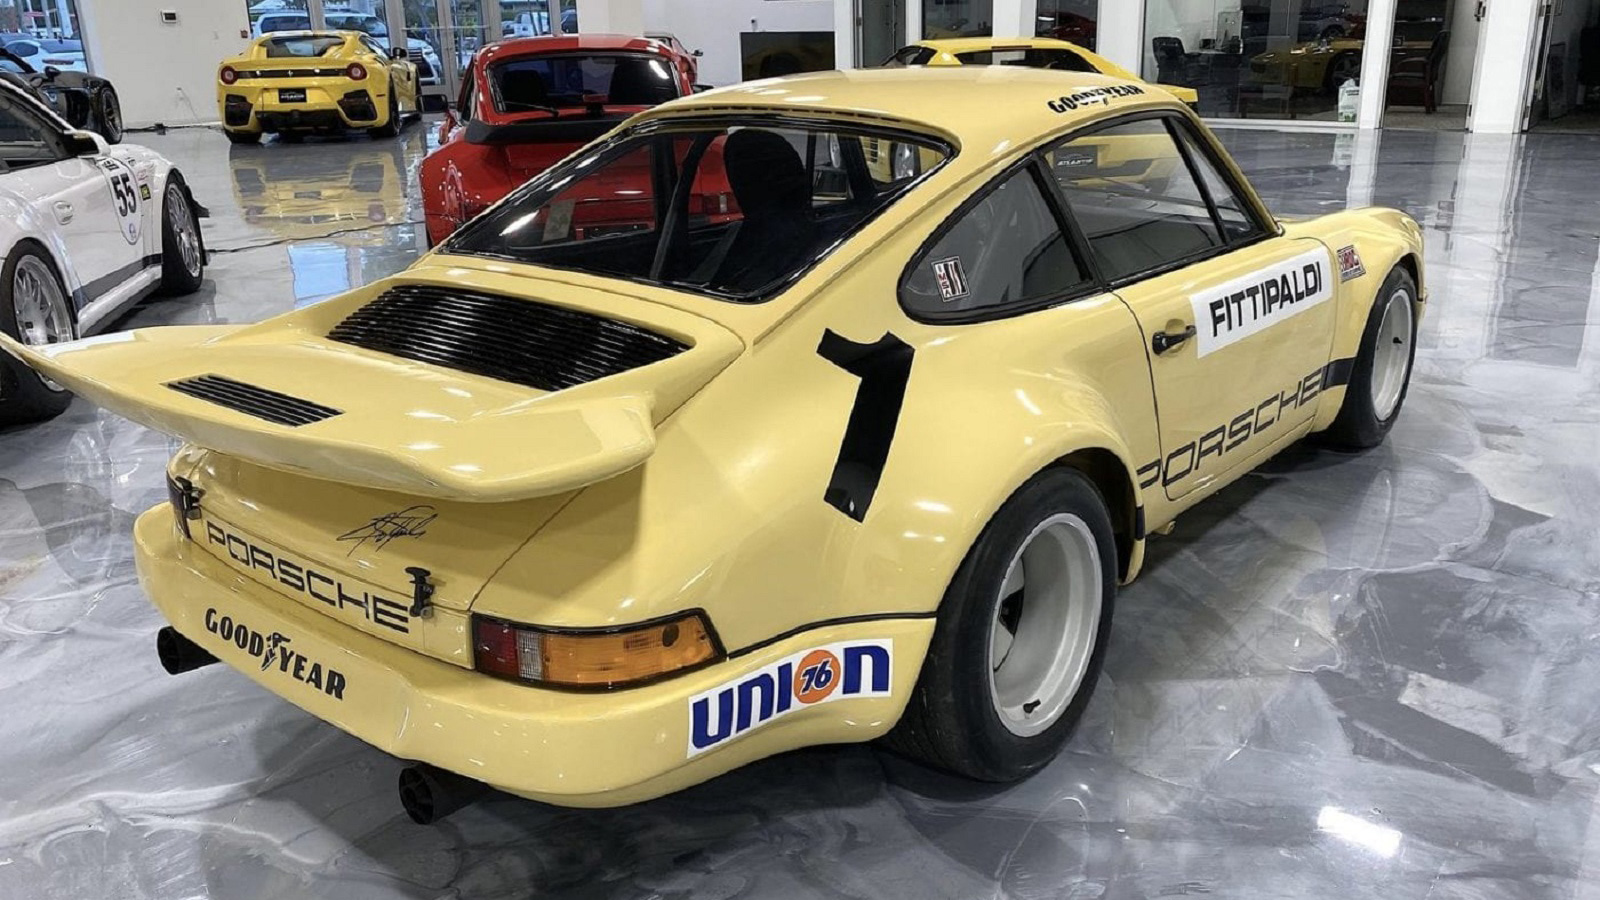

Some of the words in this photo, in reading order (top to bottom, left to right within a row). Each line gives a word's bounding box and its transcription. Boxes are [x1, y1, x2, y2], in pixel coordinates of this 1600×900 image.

[110, 173, 137, 217] 55
[1209, 261, 1322, 337] FITTIPALDI
[816, 327, 915, 523] 1
[1136, 367, 1322, 490] PORSCHE
[206, 520, 409, 634] PORSCHE
[801, 658, 833, 694] 76
